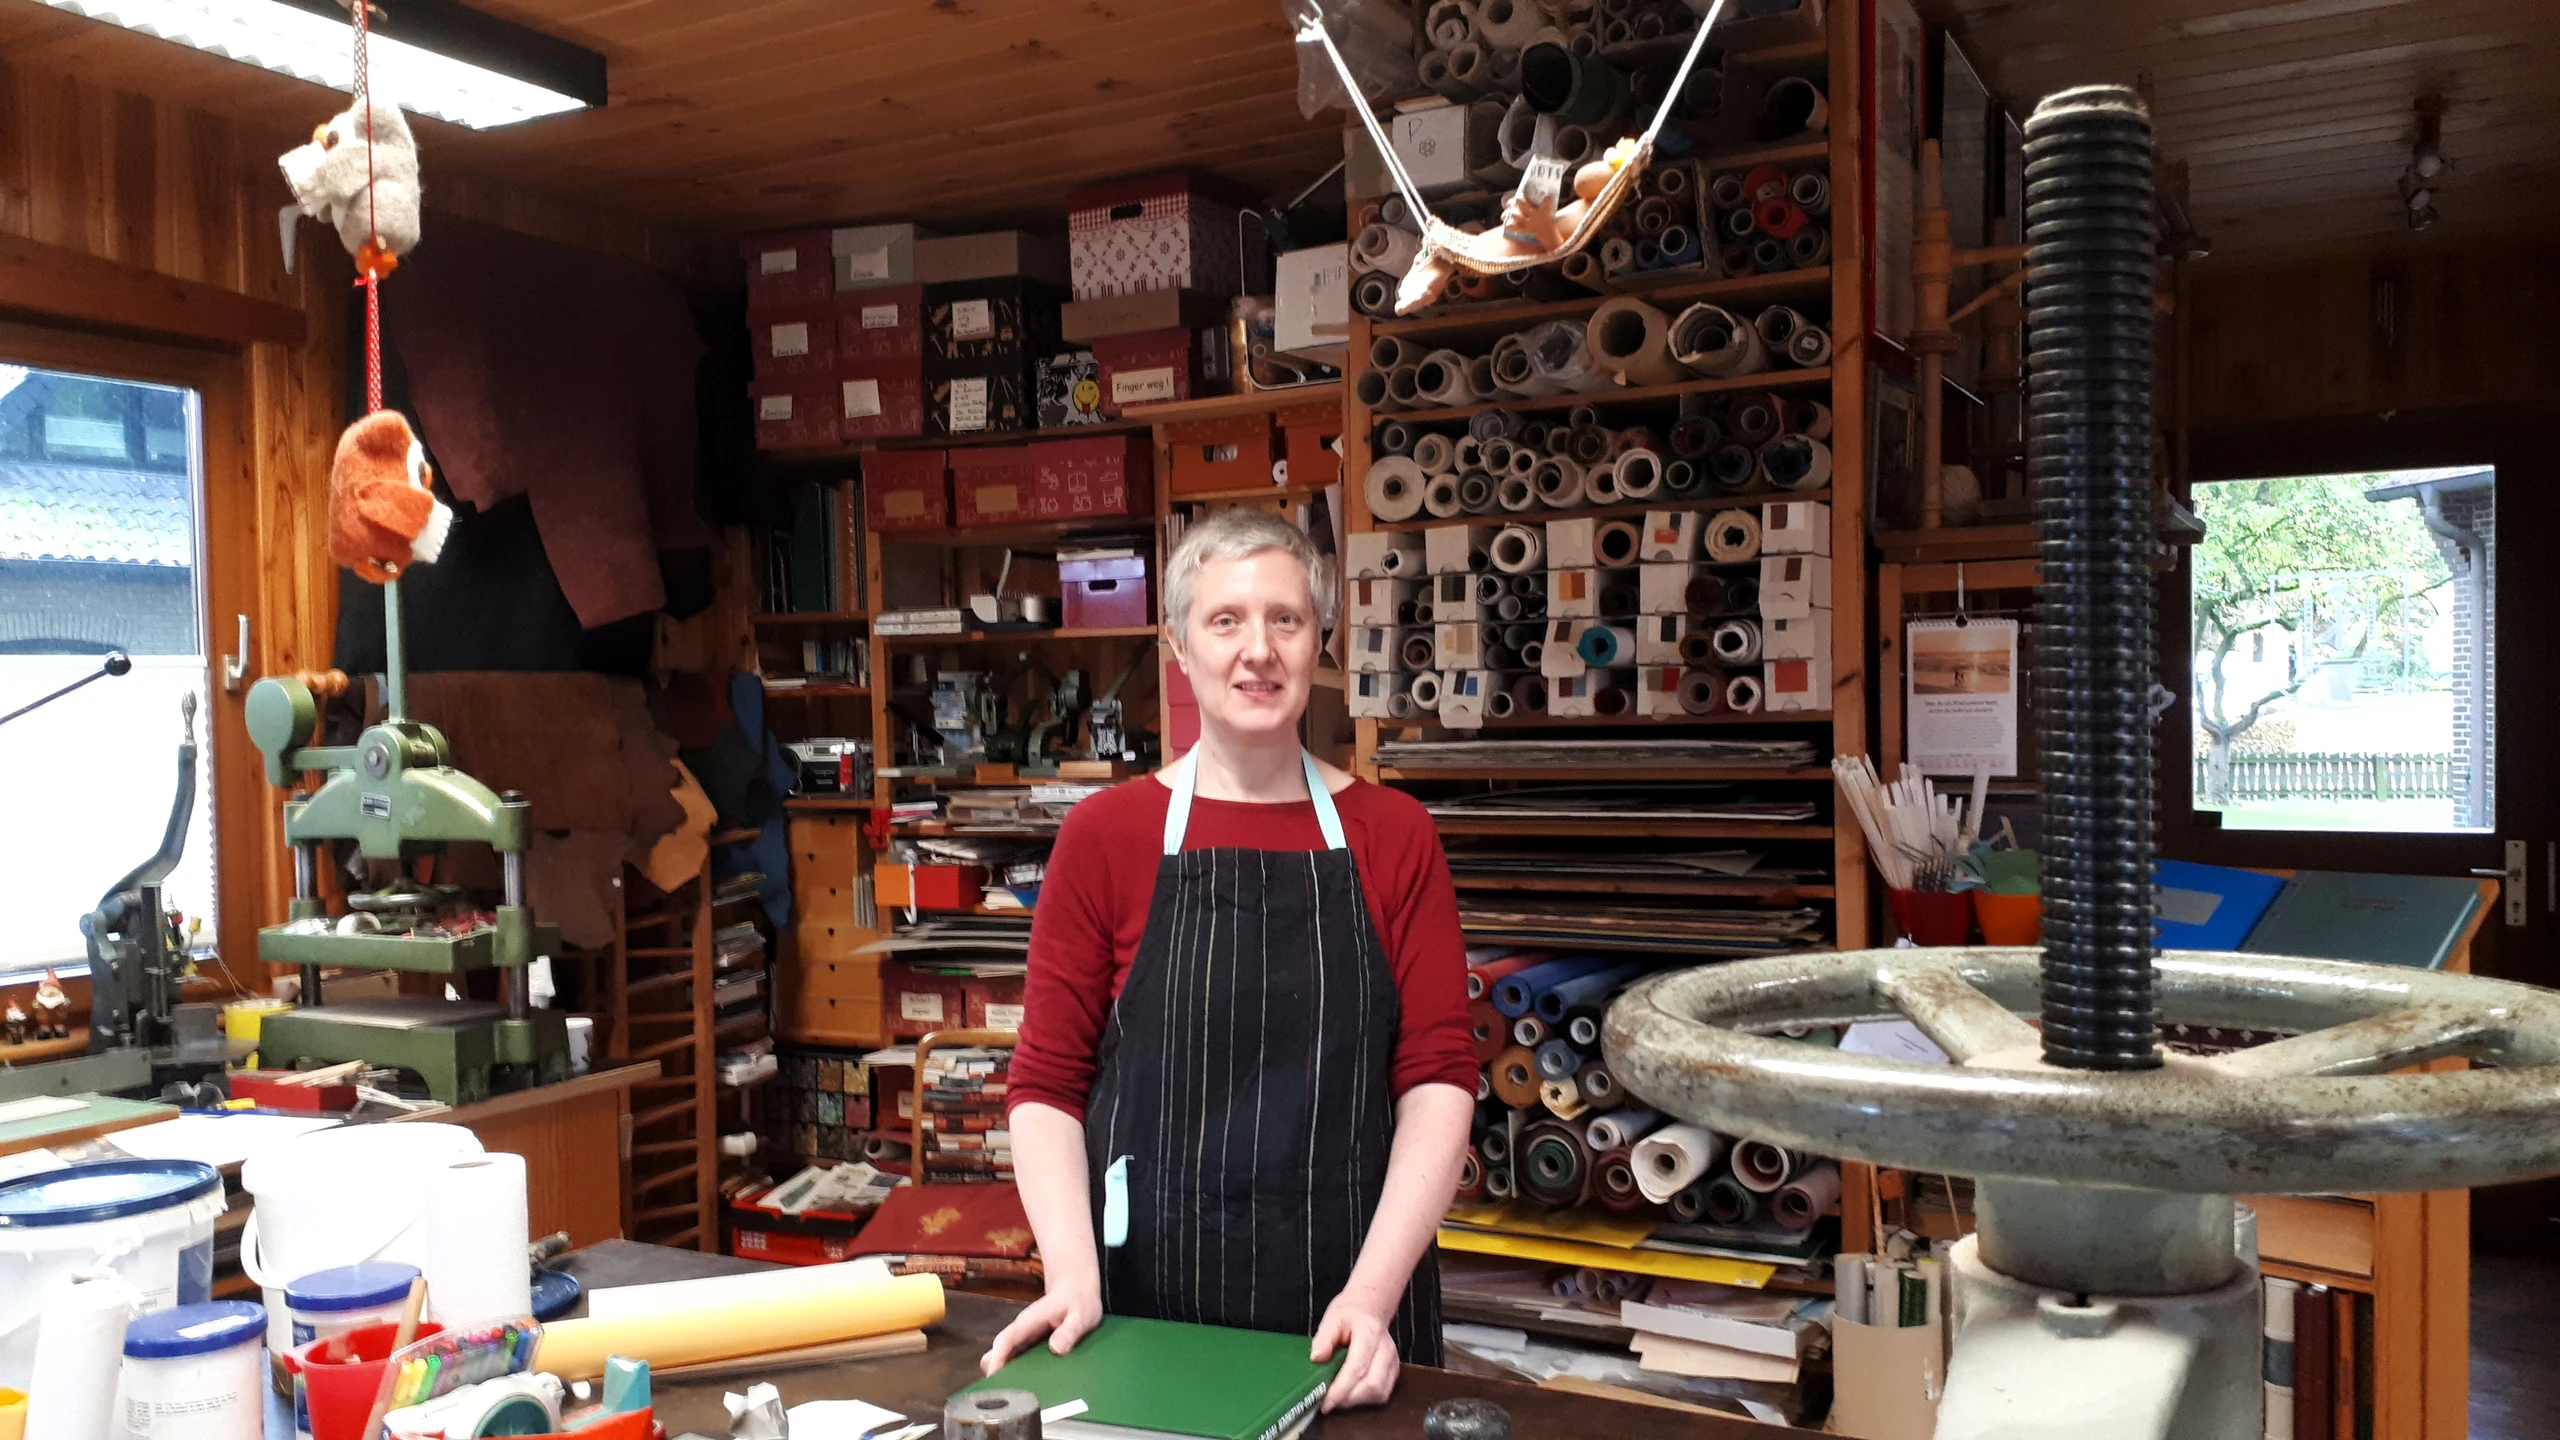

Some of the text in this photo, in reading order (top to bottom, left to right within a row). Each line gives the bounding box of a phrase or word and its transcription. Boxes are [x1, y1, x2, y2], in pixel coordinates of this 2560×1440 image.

[1408, 117, 1423, 144] P
[1116, 382, 1144, 394] Finger
[1147, 380, 1164, 392] weg
